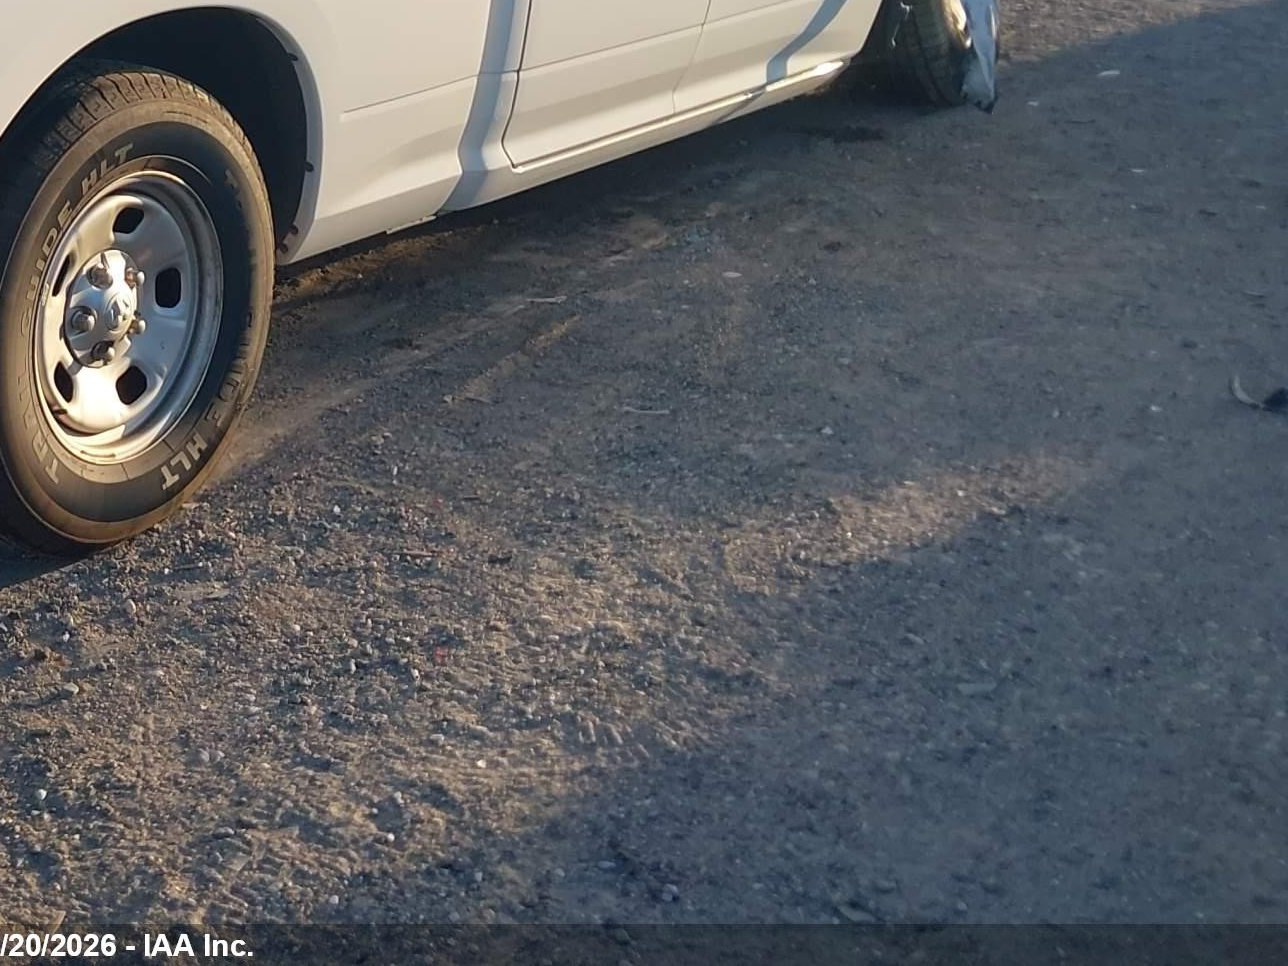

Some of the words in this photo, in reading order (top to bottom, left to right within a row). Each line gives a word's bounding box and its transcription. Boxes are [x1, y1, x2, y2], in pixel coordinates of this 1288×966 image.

[21, 199, 73, 339] GUIDE
[80, 142, 134, 196] HLT
[160, 433, 209, 491] HLT
